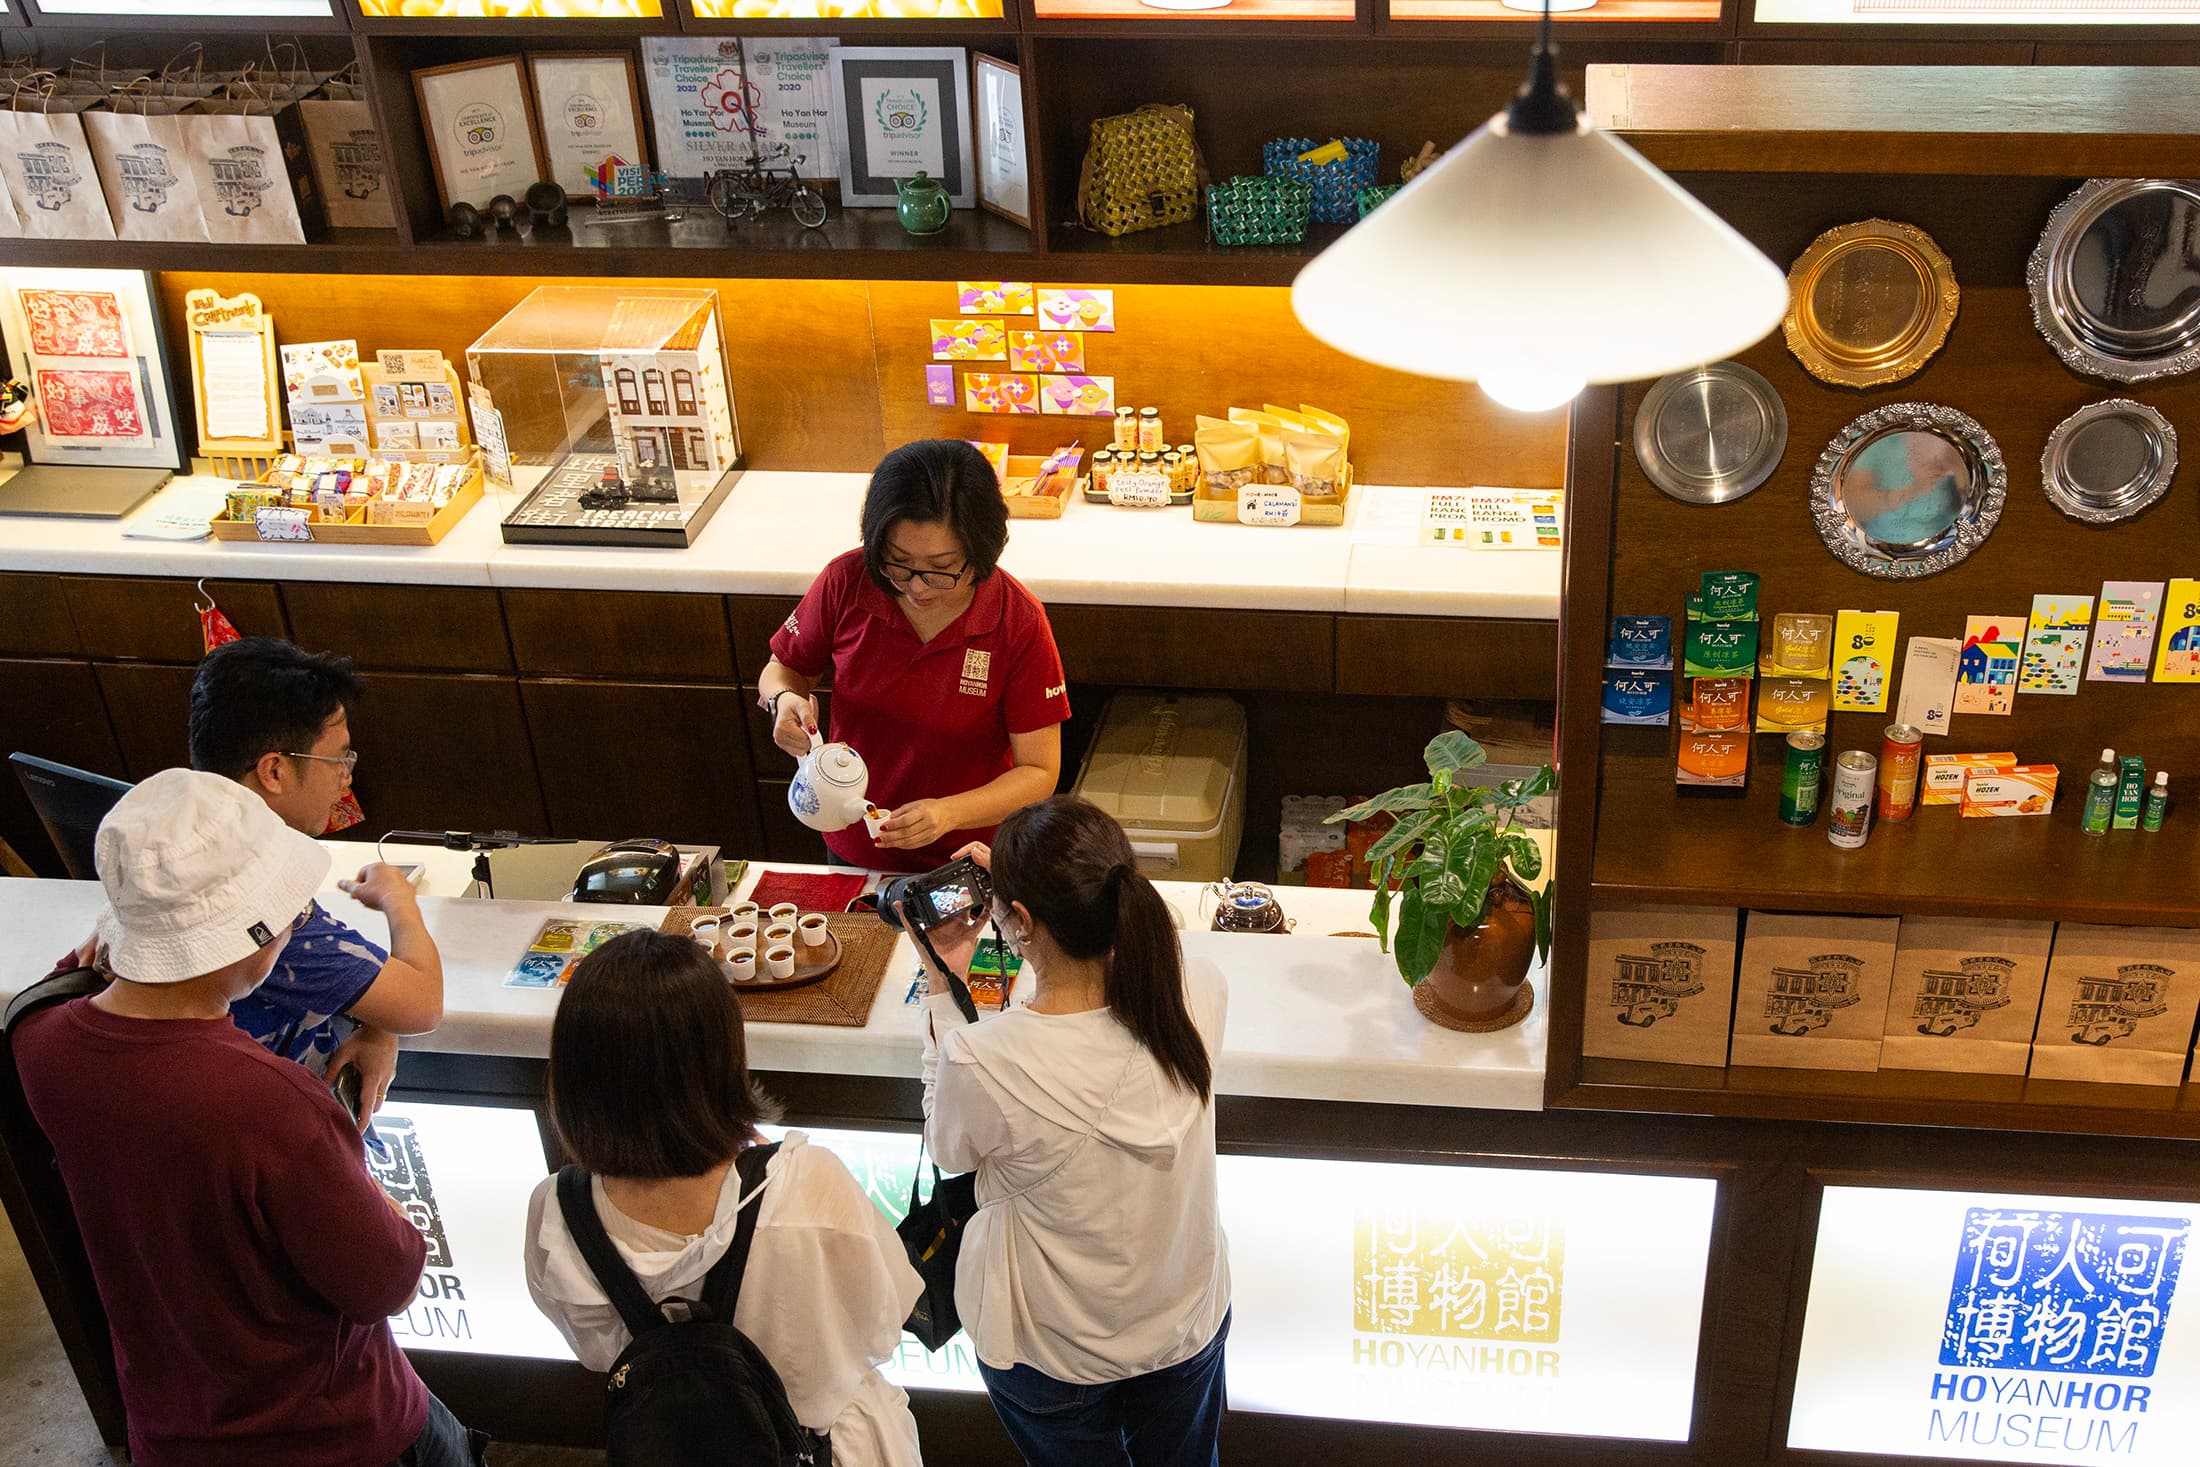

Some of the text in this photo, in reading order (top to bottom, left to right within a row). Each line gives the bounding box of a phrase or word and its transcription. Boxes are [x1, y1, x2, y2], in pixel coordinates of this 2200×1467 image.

[774, 52, 829, 64] Tripadvisor
[776, 62, 826, 72] Travellers'
[675, 74, 709, 83] Choice
[777, 72, 812, 81] Choice
[677, 84, 698, 92] 2022
[778, 83, 801, 91] 2020
[681, 109, 693, 118] Ho
[782, 109, 828, 118] Ho Yan Hor
[683, 119, 714, 128] Museum
[783, 119, 816, 128] Museum
[883, 132, 921, 140] tripadvisor
[1710, 583, 1749, 597] 何人可
[1620, 628, 1660, 640] 何人可
[1699, 633, 1742, 645] 何人可
[1781, 627, 1816, 641] 何人可
[958, 686, 987, 697] MUSEUM
[1614, 680, 1656, 693] 何人可
[1699, 691, 1740, 705] 何人可
[1772, 689, 1814, 702] 何人可
[1691, 742, 1733, 755] 何人可
[1895, 754, 1915, 765] 何人
[1799, 762, 1819, 772] 何人
[1934, 773, 1959, 781] HOZEN
[1976, 786, 2000, 794] HOZEN
[2126, 782, 2138, 790] HO
[2123, 789, 2139, 797] YAN
[2121, 795, 2138, 803] HOR
[1968, 1212, 2187, 1296] 何人可
[1363, 1258, 1555, 1334] 博物館
[1957, 1291, 2161, 1372] 博物館
[1352, 1337, 1561, 1378] HOYANHOR
[1930, 1372, 2152, 1413] HOYANHOR
[1927, 1408, 2139, 1455] MUSEUM
